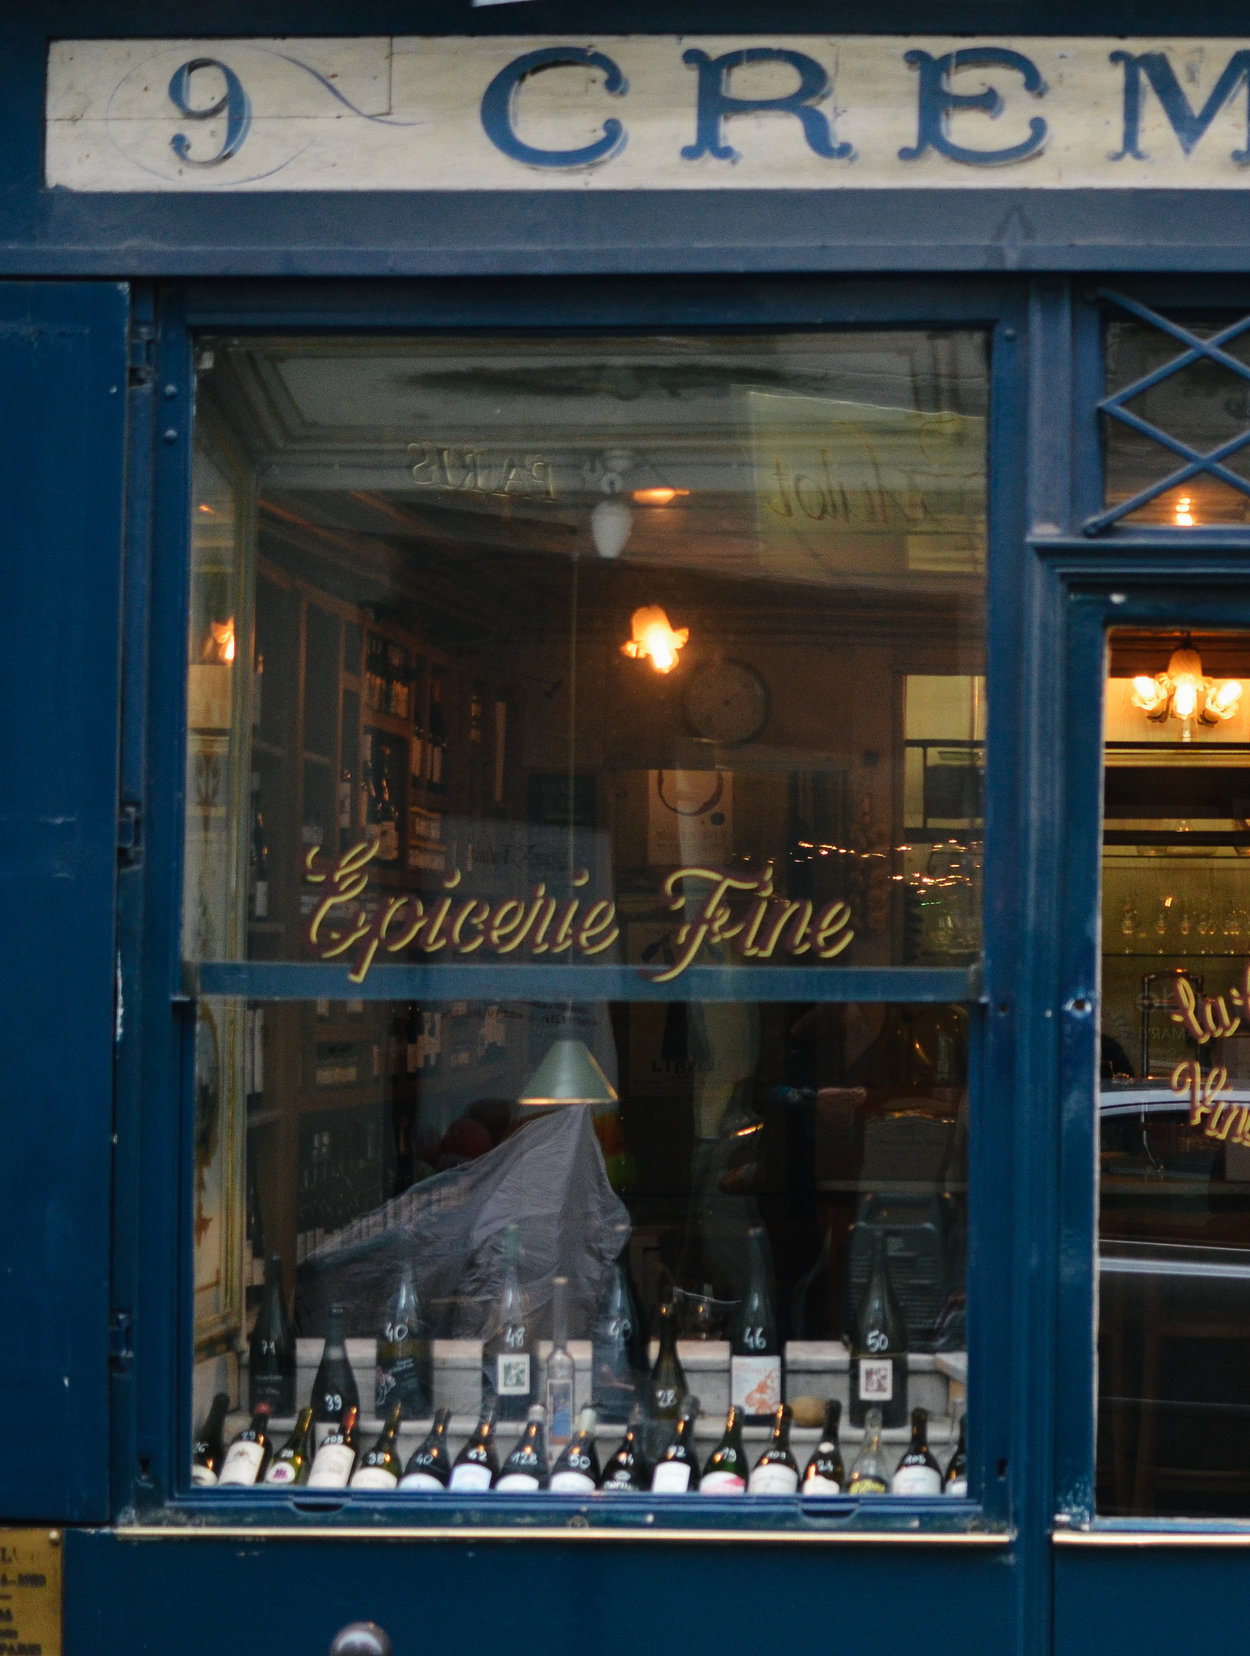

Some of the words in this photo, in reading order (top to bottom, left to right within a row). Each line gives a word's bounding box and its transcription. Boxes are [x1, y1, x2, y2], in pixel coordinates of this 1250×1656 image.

[167, 57, 252, 168] 9
[637, 866, 856, 983] Fine
[1171, 976, 1241, 1045] La
[385, 1322, 408, 1343] 40
[506, 1326, 525, 1347] 48
[743, 1327, 767, 1349] 46
[866, 1330, 889, 1352] 50
[416, 1453, 433, 1465] 40
